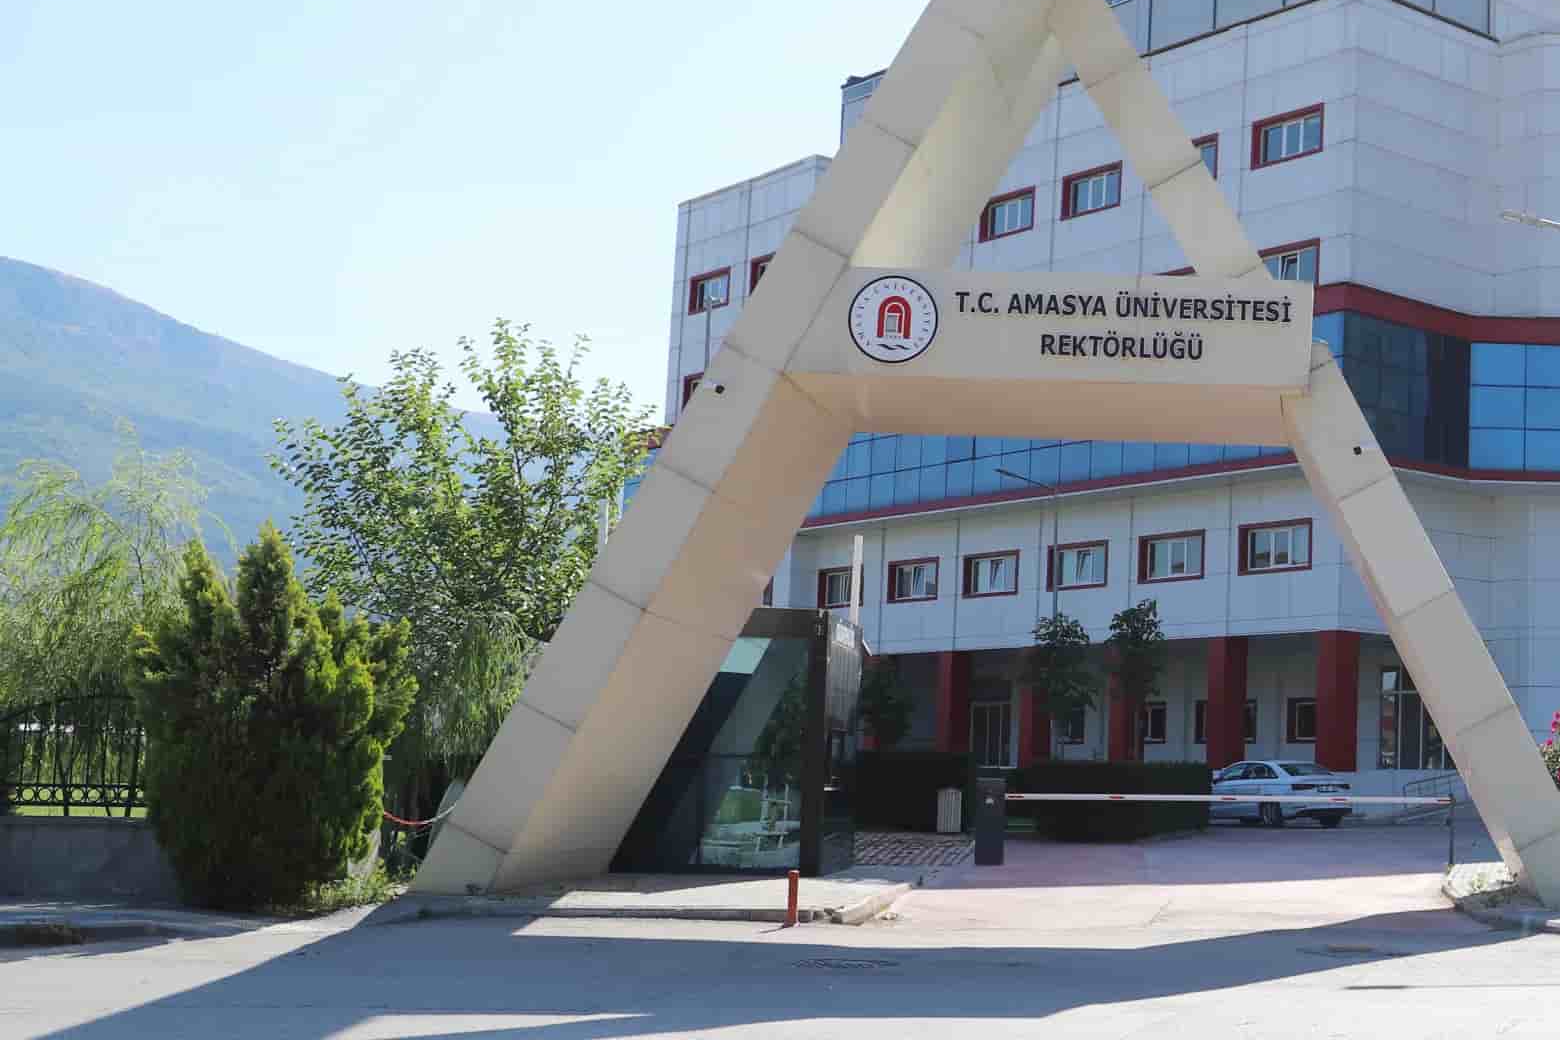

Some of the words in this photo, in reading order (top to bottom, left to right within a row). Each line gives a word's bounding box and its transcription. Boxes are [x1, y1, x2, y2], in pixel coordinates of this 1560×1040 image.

[955, 291, 999, 314] T.C.
[1007, 293, 1107, 317] AMASYA
[1116, 290, 1292, 323] ÜNİVERSİTESİ
[1040, 329, 1204, 360] REKTÖRLÜĞÜ
